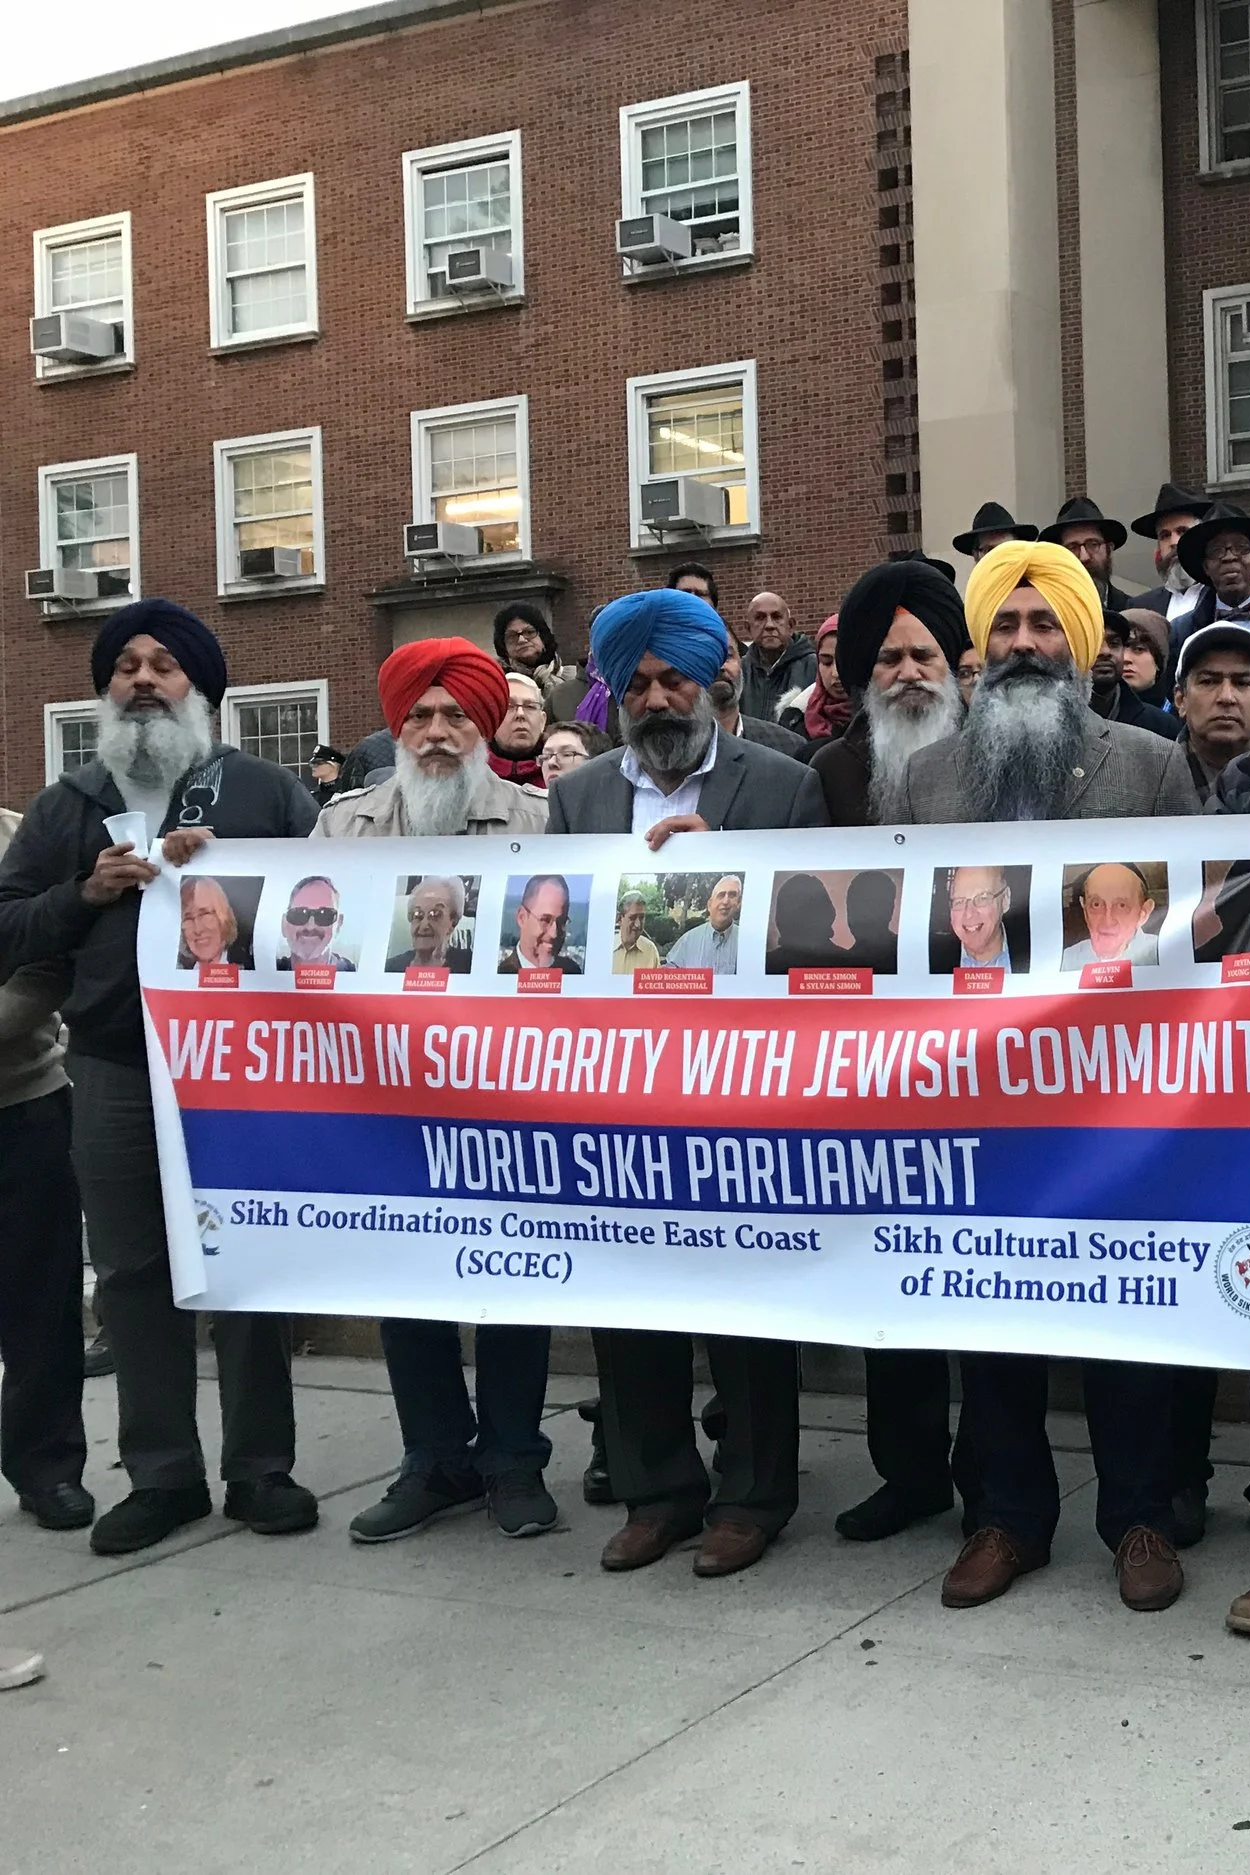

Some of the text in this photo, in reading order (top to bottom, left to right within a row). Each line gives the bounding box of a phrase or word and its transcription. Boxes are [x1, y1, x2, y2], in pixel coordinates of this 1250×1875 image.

[1090, 965, 1121, 975] MELVIN
[417, 971, 437, 980] ROSE
[529, 972, 551, 981] JERRY
[640, 972, 706, 982] DAVID ROSENTHAL
[832, 972, 858, 981] SIMON
[964, 972, 994, 981] DANIEL
[1094, 975, 1115, 983] WAX
[517, 981, 562, 990] RABINOWITZ
[638, 982, 709, 991] & CECIL ROSENTHAL
[799, 982, 862, 990] & SYLVAN SIMON
[966, 981, 990, 990] STEIN
[168, 1018, 234, 1082] WE
[246, 1020, 364, 1085] STAND
[375, 1023, 411, 1088] IN
[423, 1025, 671, 1096] SOLIDARITY
[682, 1029, 797, 1097] WITH
[803, 1027, 981, 1099] JEWISH
[421, 1124, 981, 1206] WORLD SIKH PARLIAMENT
[230, 1198, 289, 1228] Sikh
[296, 1203, 493, 1238] Coordinations
[499, 1216, 656, 1247] Committee
[662, 1221, 727, 1249] East
[734, 1223, 822, 1253] Coast
[872, 1225, 943, 1255] Sikh
[951, 1228, 1080, 1261] Cultural
[1087, 1230, 1212, 1272] Society
[454, 1247, 574, 1284] (SCCEC)
[899, 1269, 1180, 1307] of Richmond Hill
[1221, 1272, 1239, 1302] WORLD
